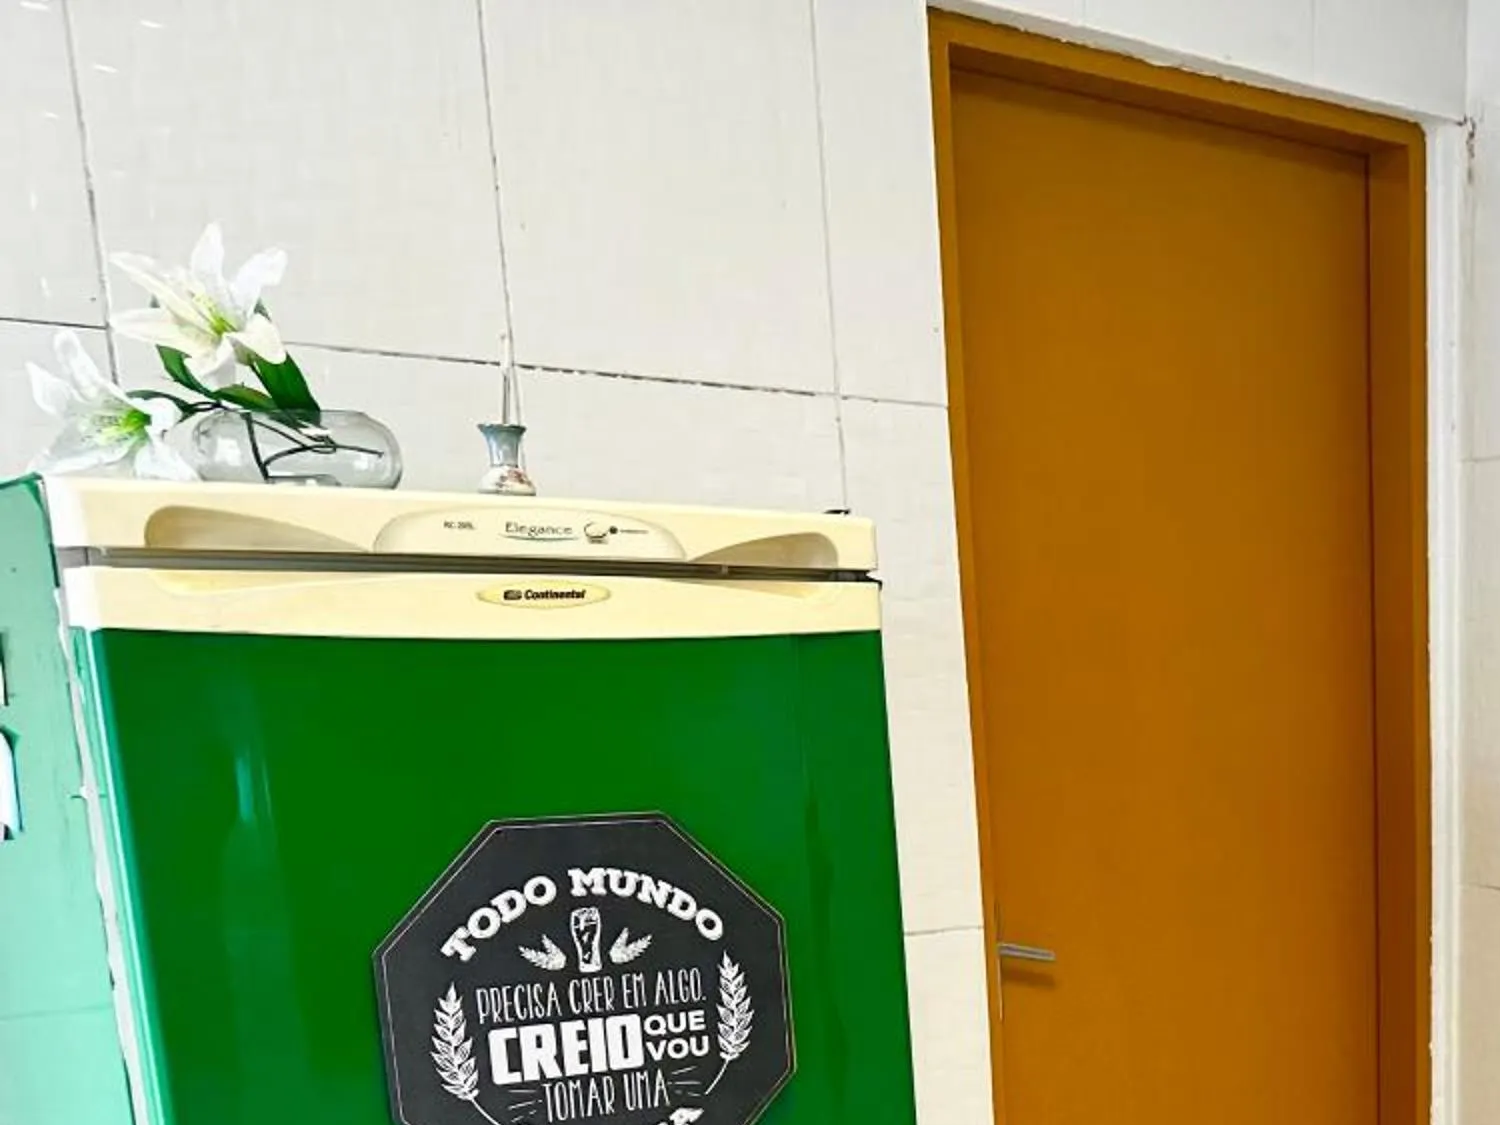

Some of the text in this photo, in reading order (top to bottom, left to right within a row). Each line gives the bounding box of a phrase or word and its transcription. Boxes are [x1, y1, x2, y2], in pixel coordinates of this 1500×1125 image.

[504, 521, 573, 537] Elegance
[524, 588, 587, 600] Continental
[440, 867, 724, 962] TODO MUNDO
[475, 982, 561, 1024] PRECISA
[569, 976, 614, 1013] CRER
[621, 974, 649, 1008] EM
[487, 1009, 706, 1085] CREIO QUE
[646, 1035, 710, 1061] VOU
[541, 1068, 671, 1123] TOMAR UMA
